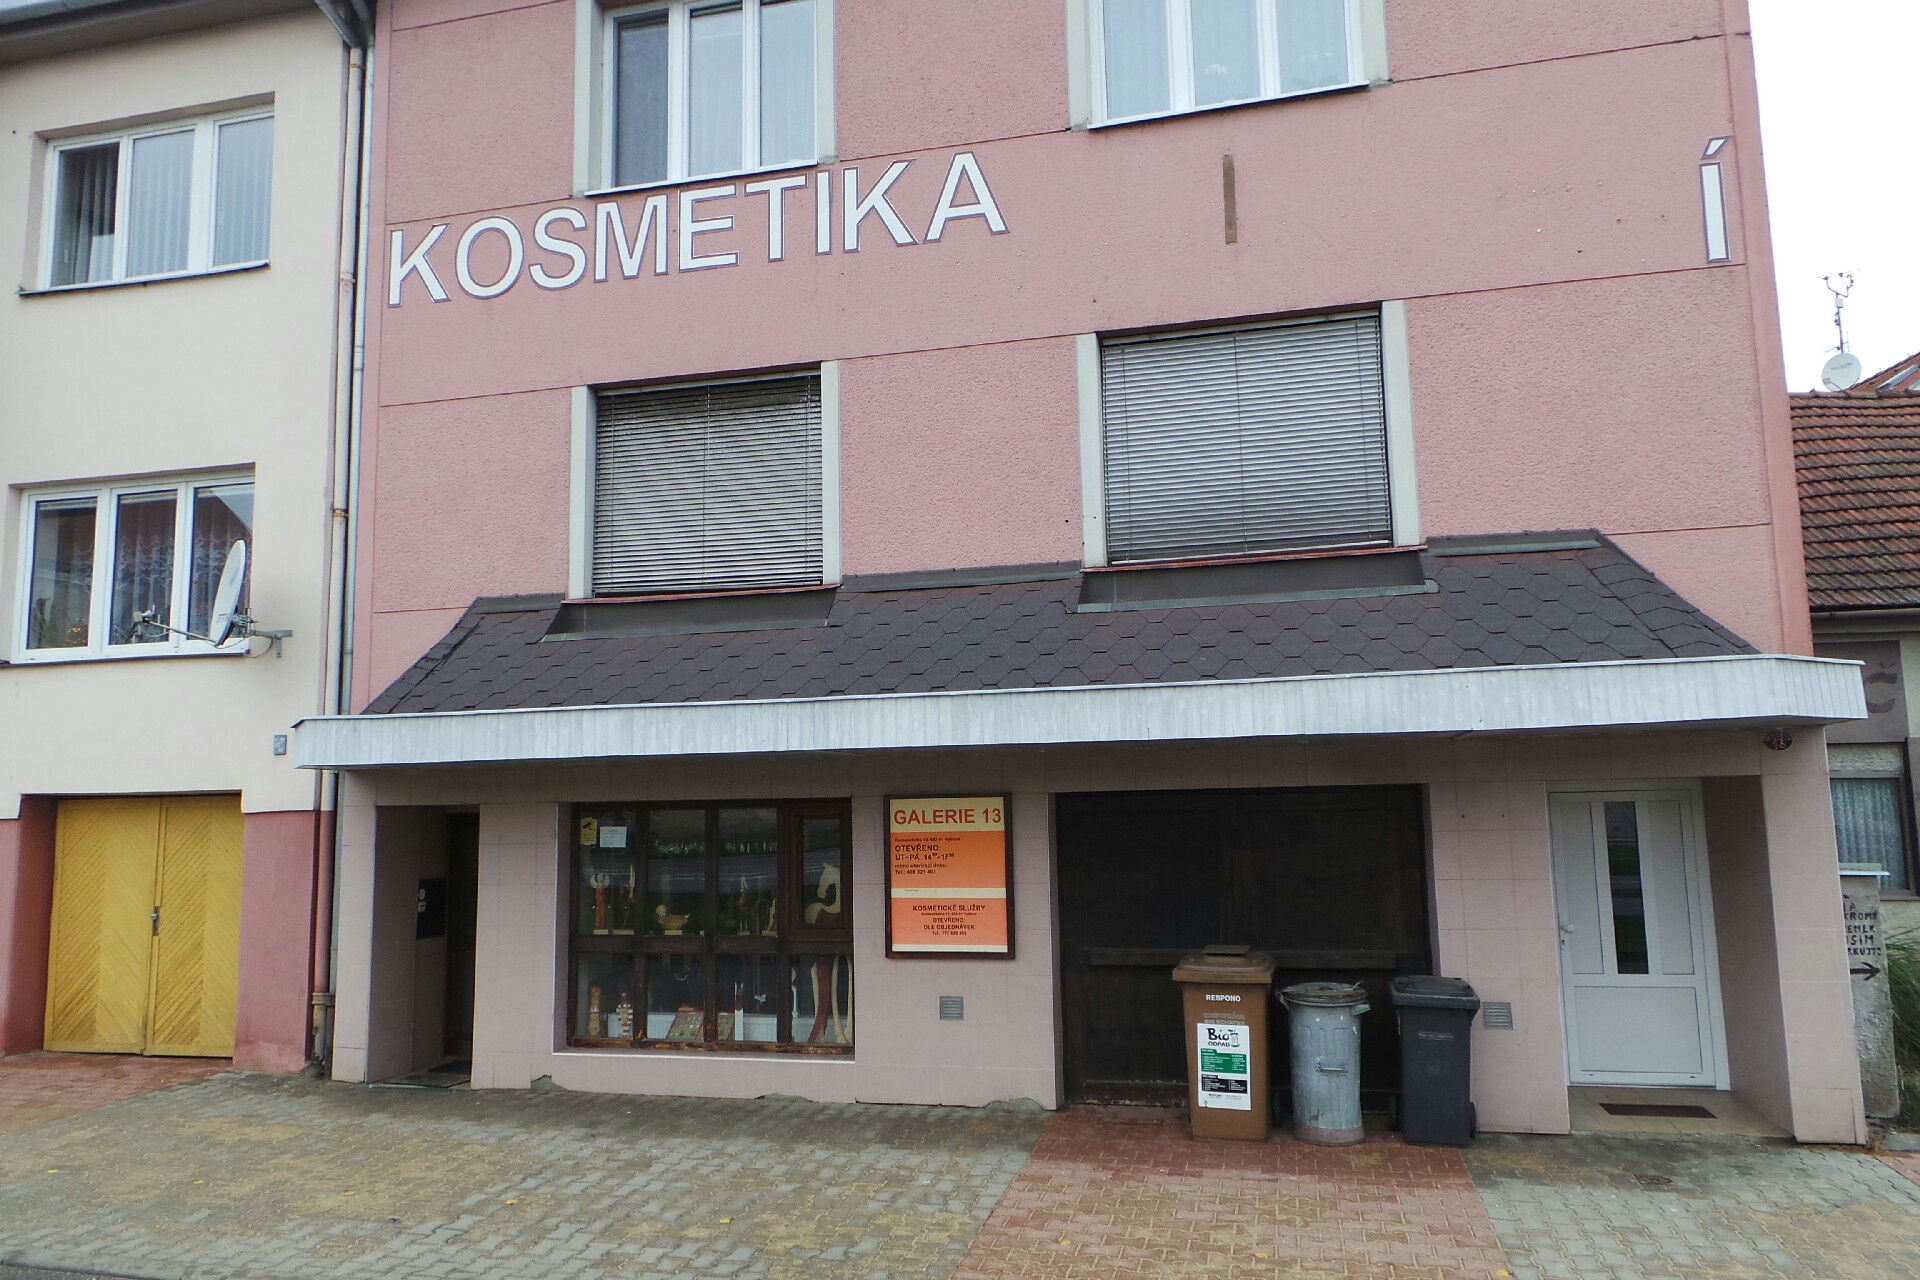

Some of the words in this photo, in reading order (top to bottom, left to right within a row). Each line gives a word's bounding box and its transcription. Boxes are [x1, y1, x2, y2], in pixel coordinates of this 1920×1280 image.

[387, 151, 1009, 308] KOSMETIKA
[893, 809, 975, 824] GALERIE
[982, 808, 1001, 823] 13
[1205, 994, 1241, 1002] RESPONO
[1206, 1027, 1230, 1041] Bio
